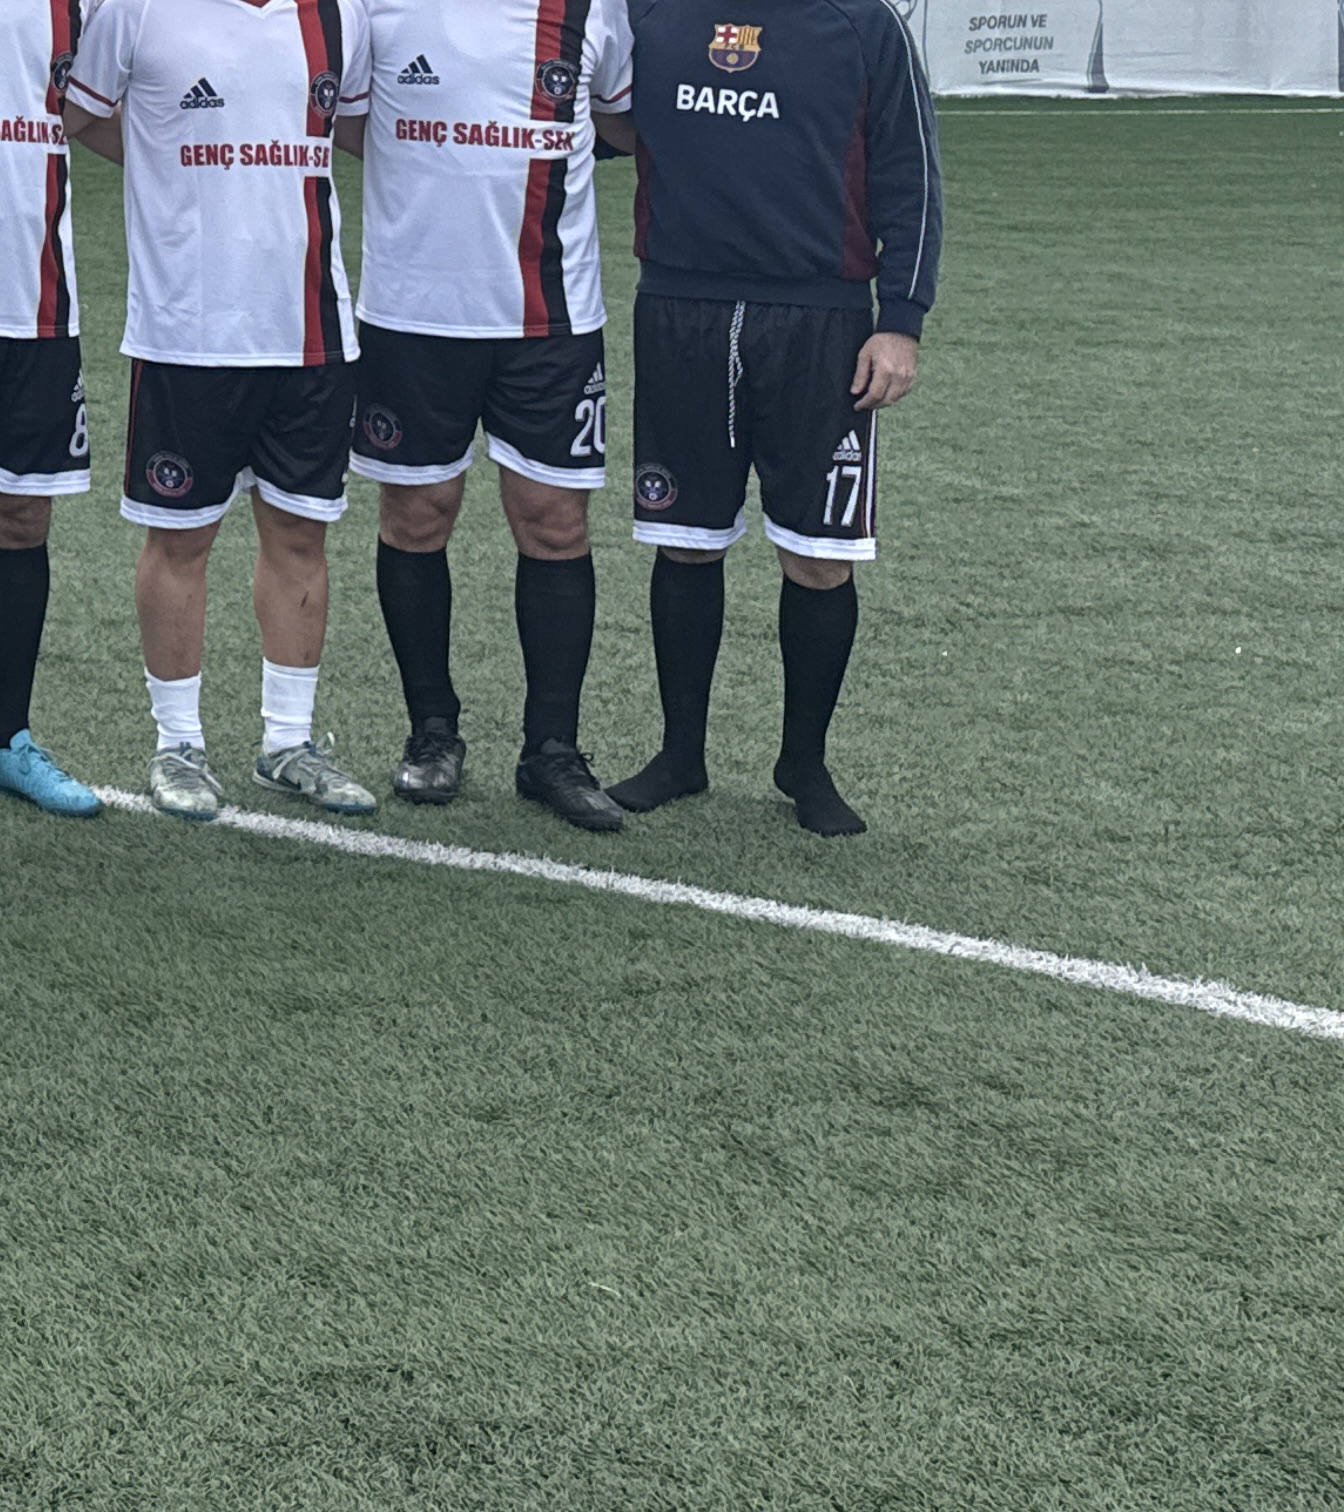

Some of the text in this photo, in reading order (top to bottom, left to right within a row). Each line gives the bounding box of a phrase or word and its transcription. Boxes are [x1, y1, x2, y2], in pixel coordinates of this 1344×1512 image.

[968, 13, 1048, 32] SPORUN VE
[964, 36, 1054, 55] SPORCUNUN
[396, 73, 440, 86] adidas
[978, 58, 1041, 75] YANINDA
[179, 96, 225, 110] adidas
[676, 83, 780, 123] BARÇA
[395, 117, 448, 148] GENÇ
[179, 142, 235, 171] GENÇ
[69, 403, 89, 458] 8
[569, 395, 607, 458] 20
[822, 465, 862, 528] 17
